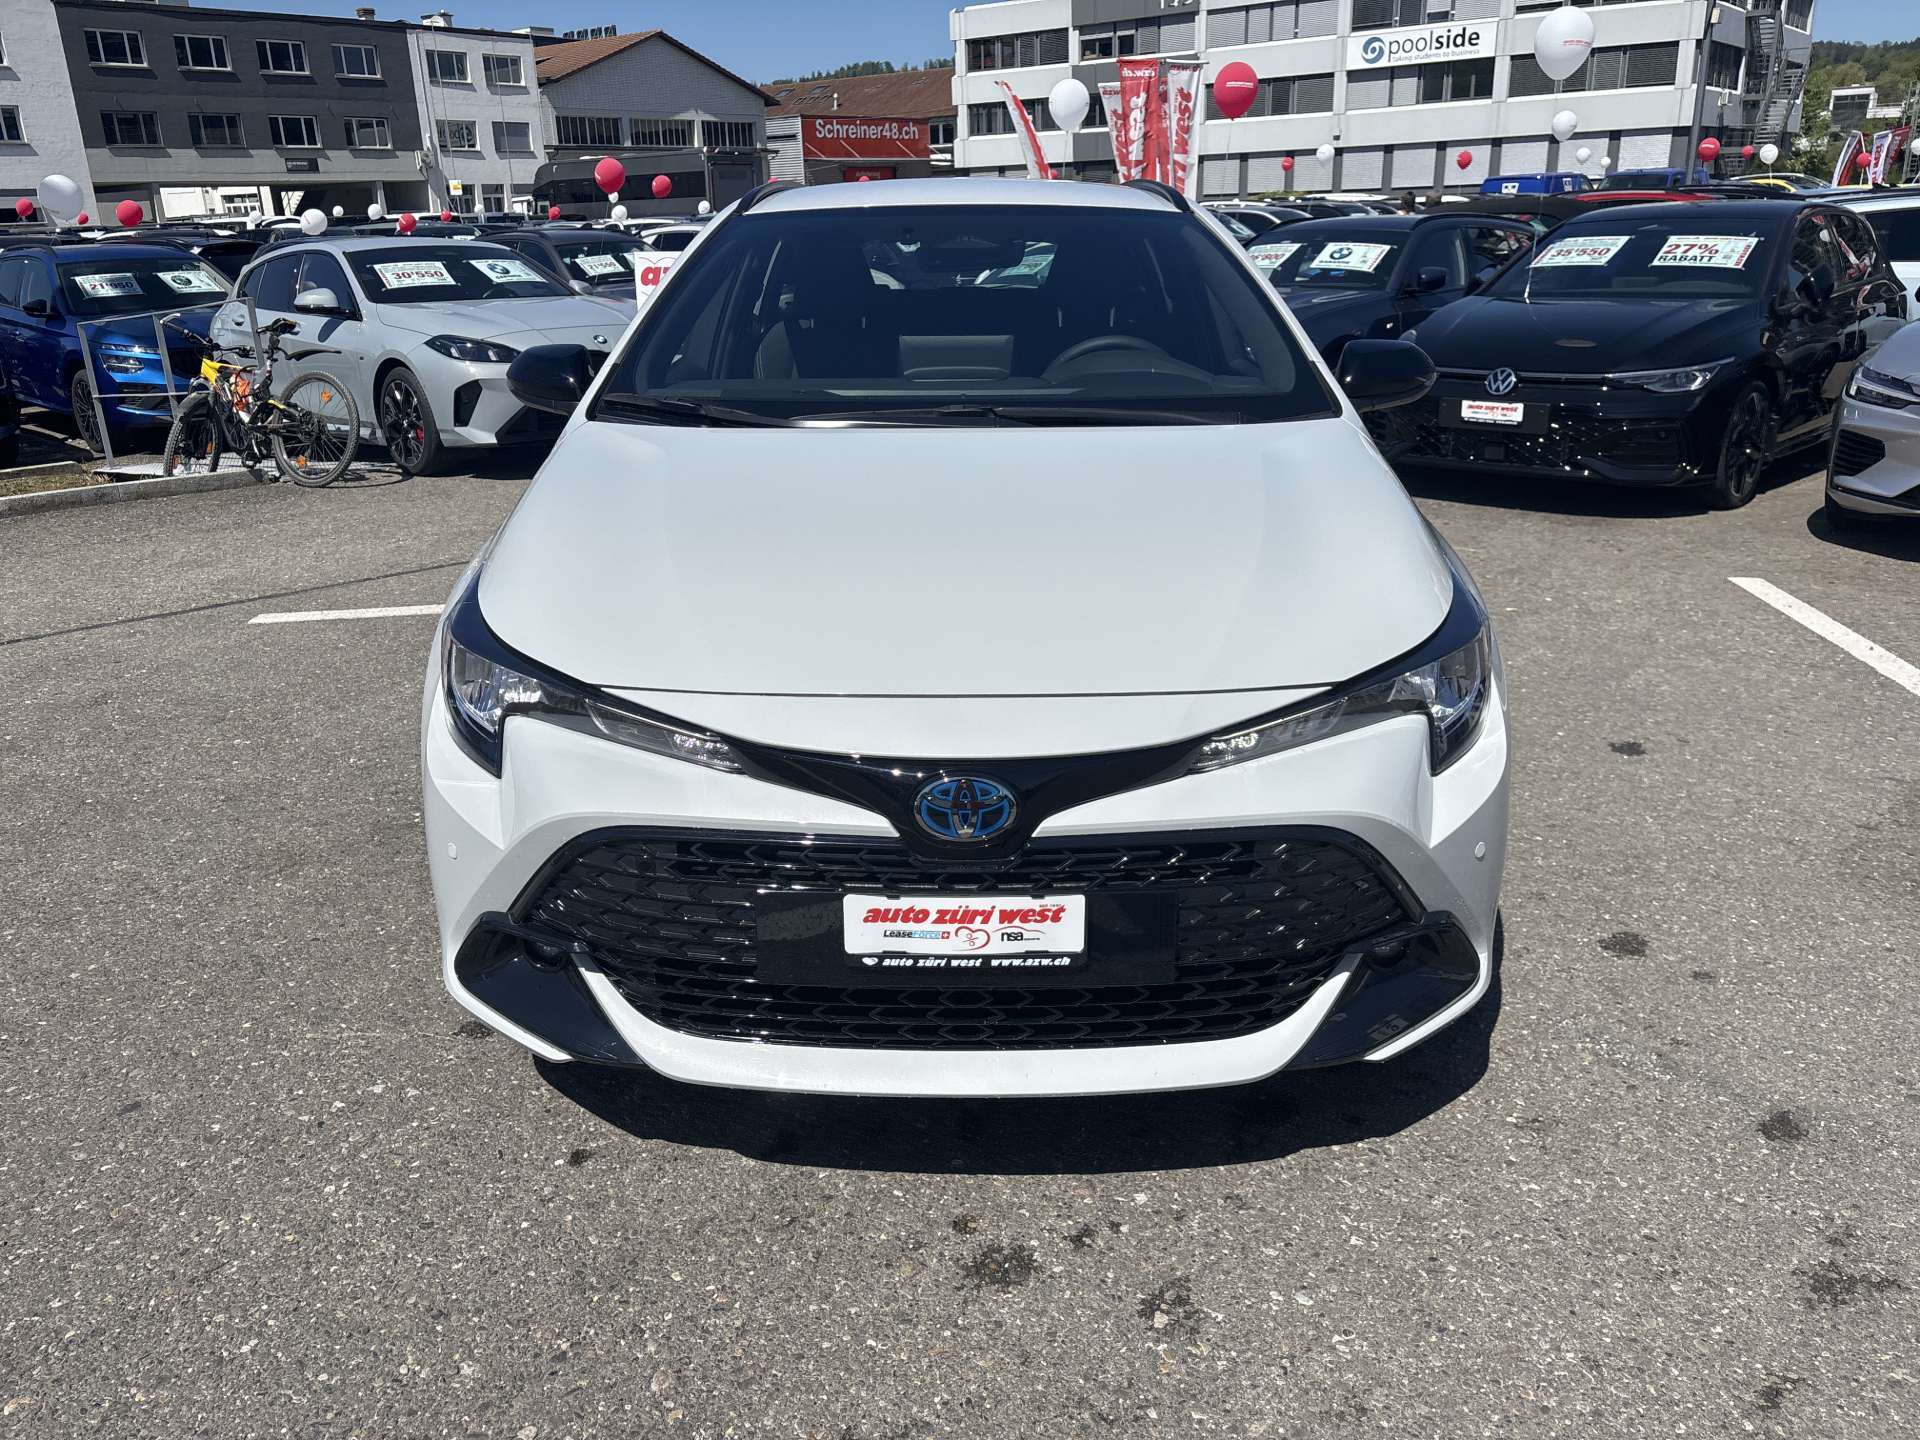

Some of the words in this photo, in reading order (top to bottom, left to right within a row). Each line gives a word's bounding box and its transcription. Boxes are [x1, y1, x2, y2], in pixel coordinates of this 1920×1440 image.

[1388, 27, 1480, 62] poolside
[1414, 52, 1442, 60] students
[1451, 48, 1480, 57] business
[1173, 87, 1192, 155] west
[816, 119, 919, 139] Schreiner48.ch
[1551, 248, 1611, 257] 35'550
[1663, 243, 1719, 255] 27%
[1658, 255, 1716, 263] RABATT
[392, 271, 444, 279] 30'550
[863, 905, 930, 924] auto
[931, 905, 996, 925] züri
[999, 905, 1066, 924] west
[1001, 931, 1023, 941] nsa
[882, 958, 914, 967] auto
[917, 957, 947, 967] züri
[950, 958, 982, 967] west
[991, 957, 1071, 967] www.azw.ch
